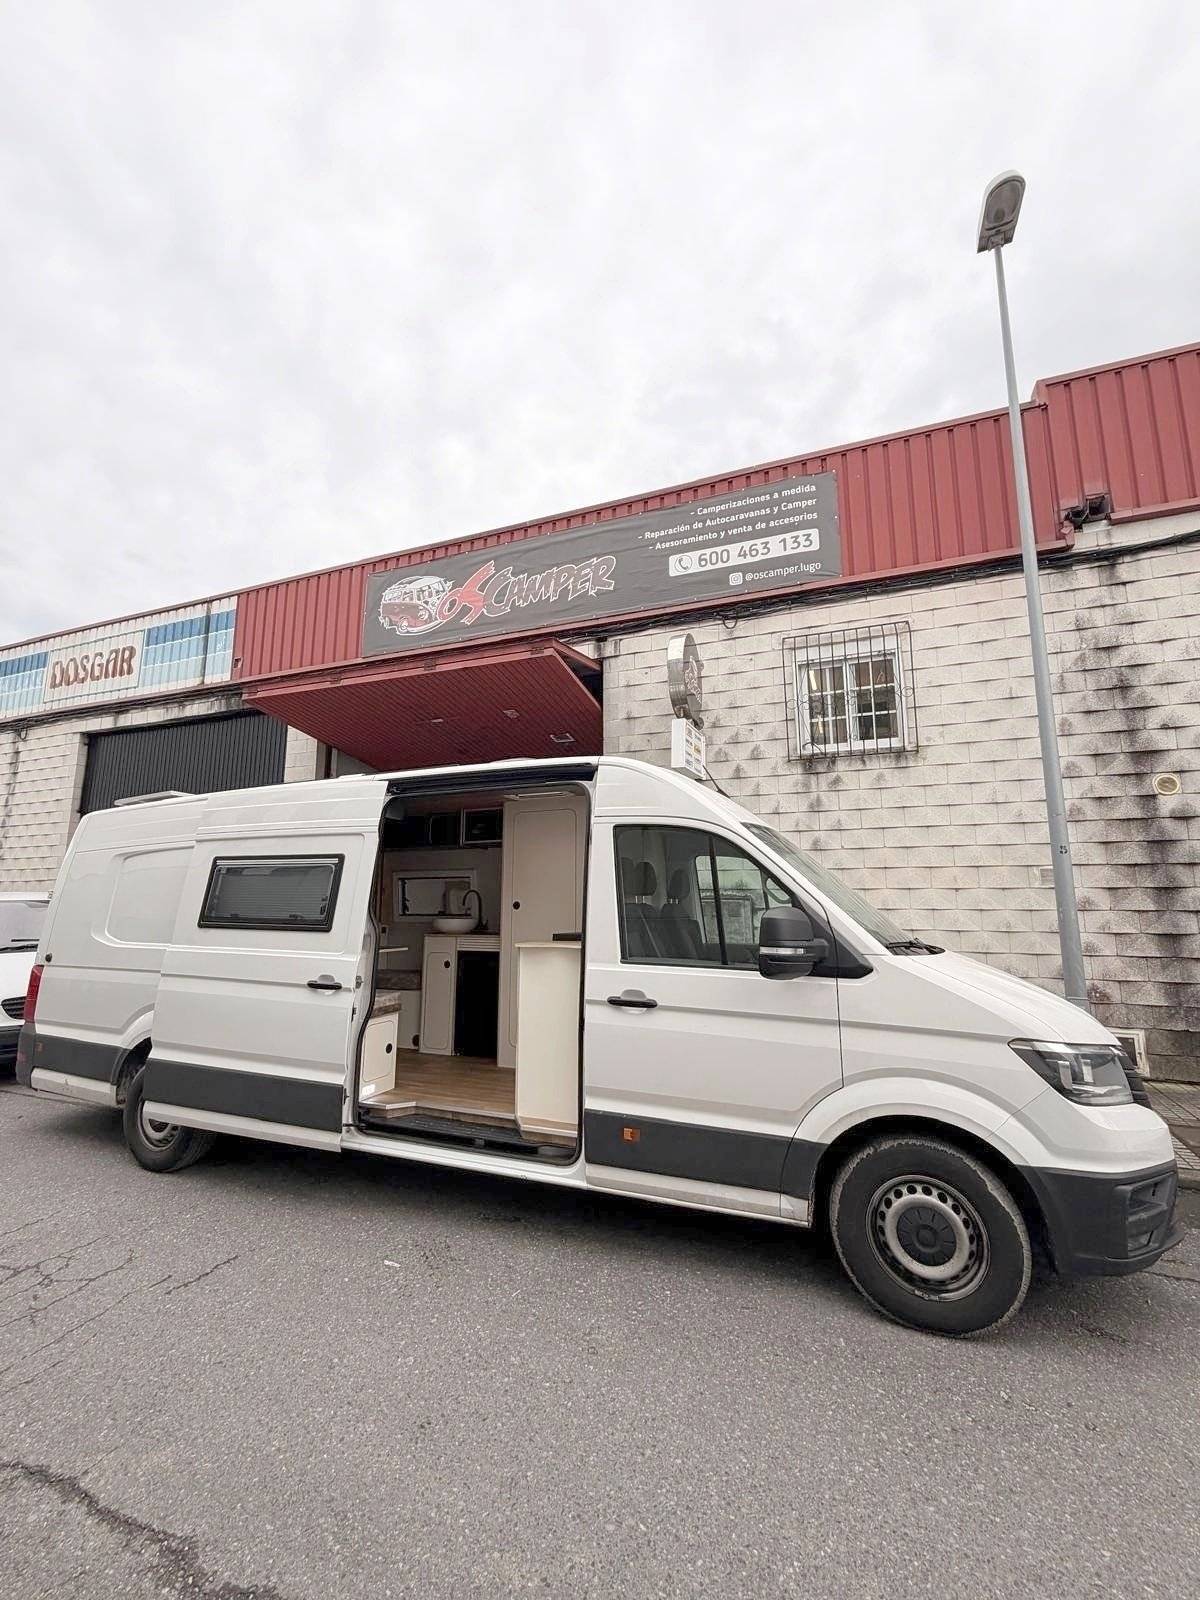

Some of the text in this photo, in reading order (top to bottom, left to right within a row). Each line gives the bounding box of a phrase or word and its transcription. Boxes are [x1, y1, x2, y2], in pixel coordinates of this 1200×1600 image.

[697, 494, 771, 515] Camperizaciones
[781, 484, 817, 497] medida
[644, 523, 690, 540] Reparación
[692, 521, 703, 529] de
[705, 507, 771, 527] Autocaravanas
[773, 505, 779, 514] y
[781, 498, 817, 511] Camper
[655, 532, 718, 550] Asesoramiento
[719, 530, 726, 538] y
[727, 524, 753, 535] venta
[755, 521, 766, 530] de
[769, 512, 818, 527] accesorios
[697, 533, 813, 568] 600 463 133
[745, 562, 821, 581] @oscamper.lugo
[50, 645, 137, 689] DOSGAR
